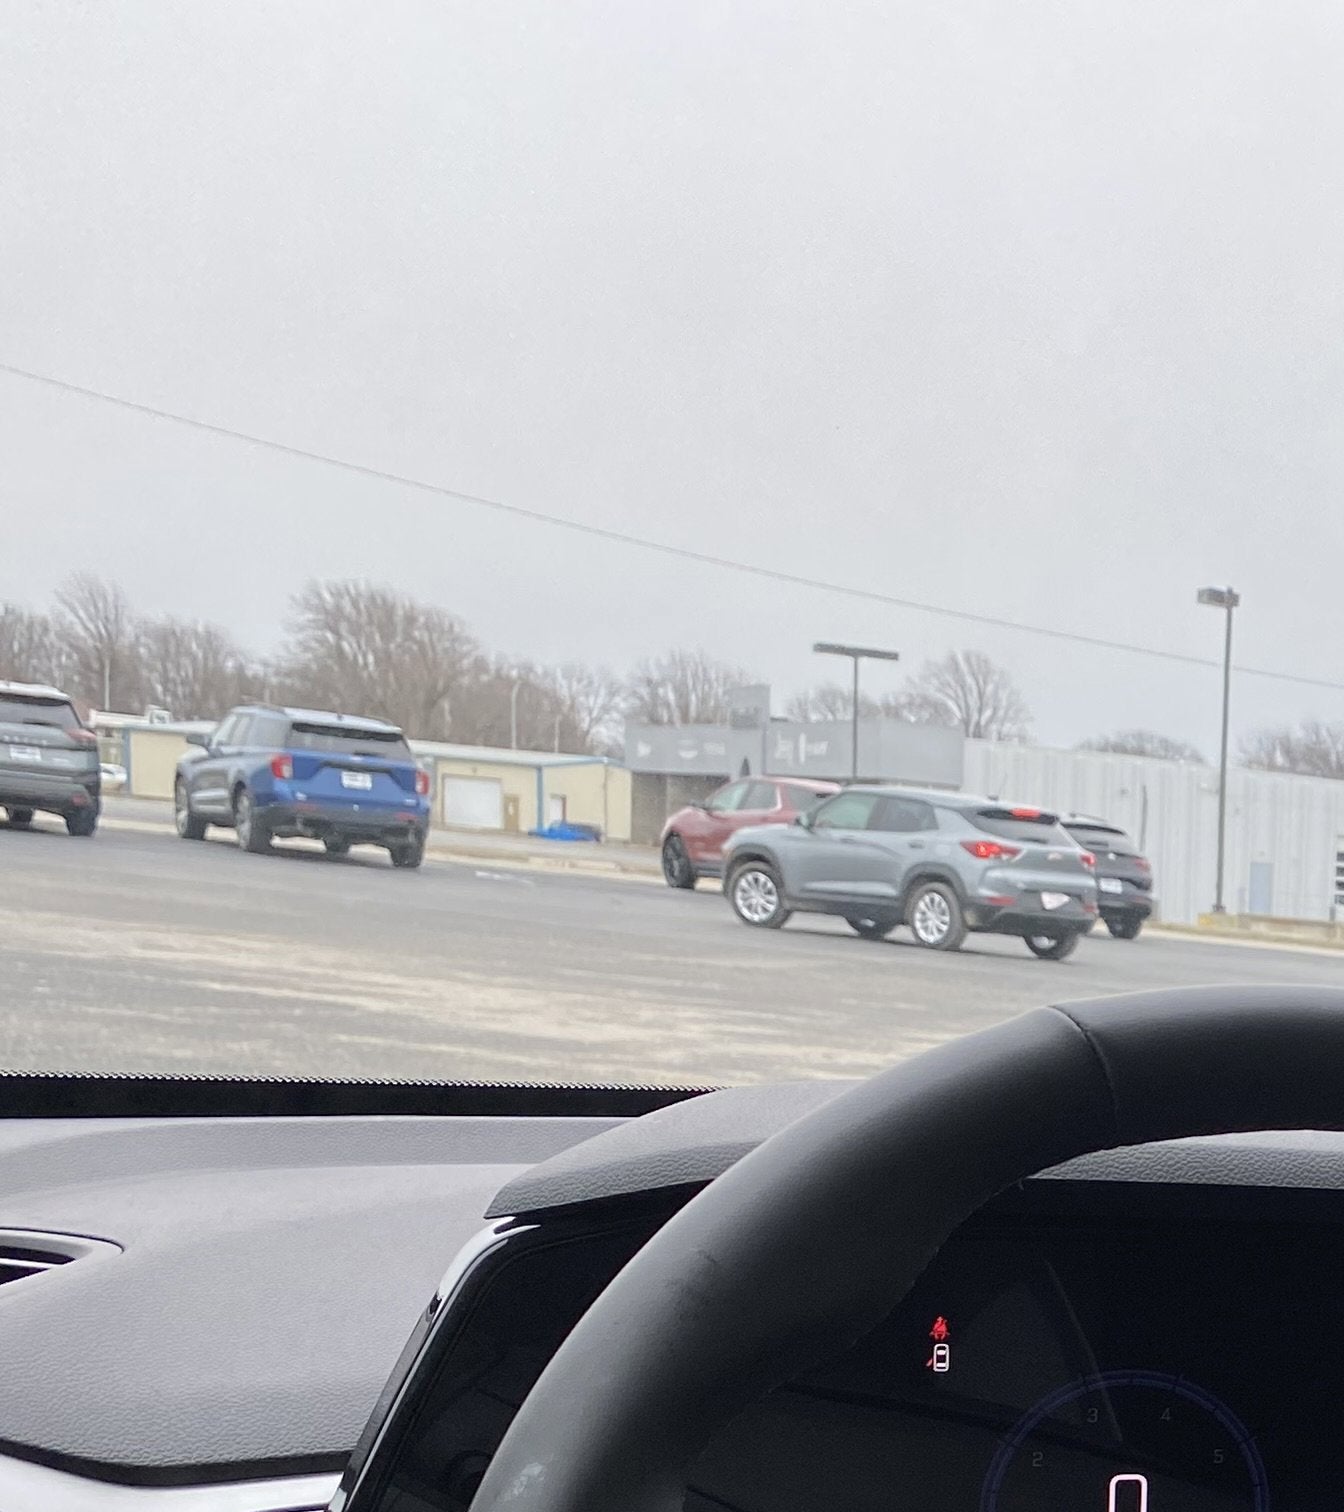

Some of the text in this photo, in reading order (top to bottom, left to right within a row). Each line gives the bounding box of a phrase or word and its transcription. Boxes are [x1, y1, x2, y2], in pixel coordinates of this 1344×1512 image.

[1087, 1408, 1098, 1423] 3
[1160, 1408, 1171, 1422] 4
[1032, 1452, 1044, 1467] 2
[1214, 1449, 1224, 1464] 5
